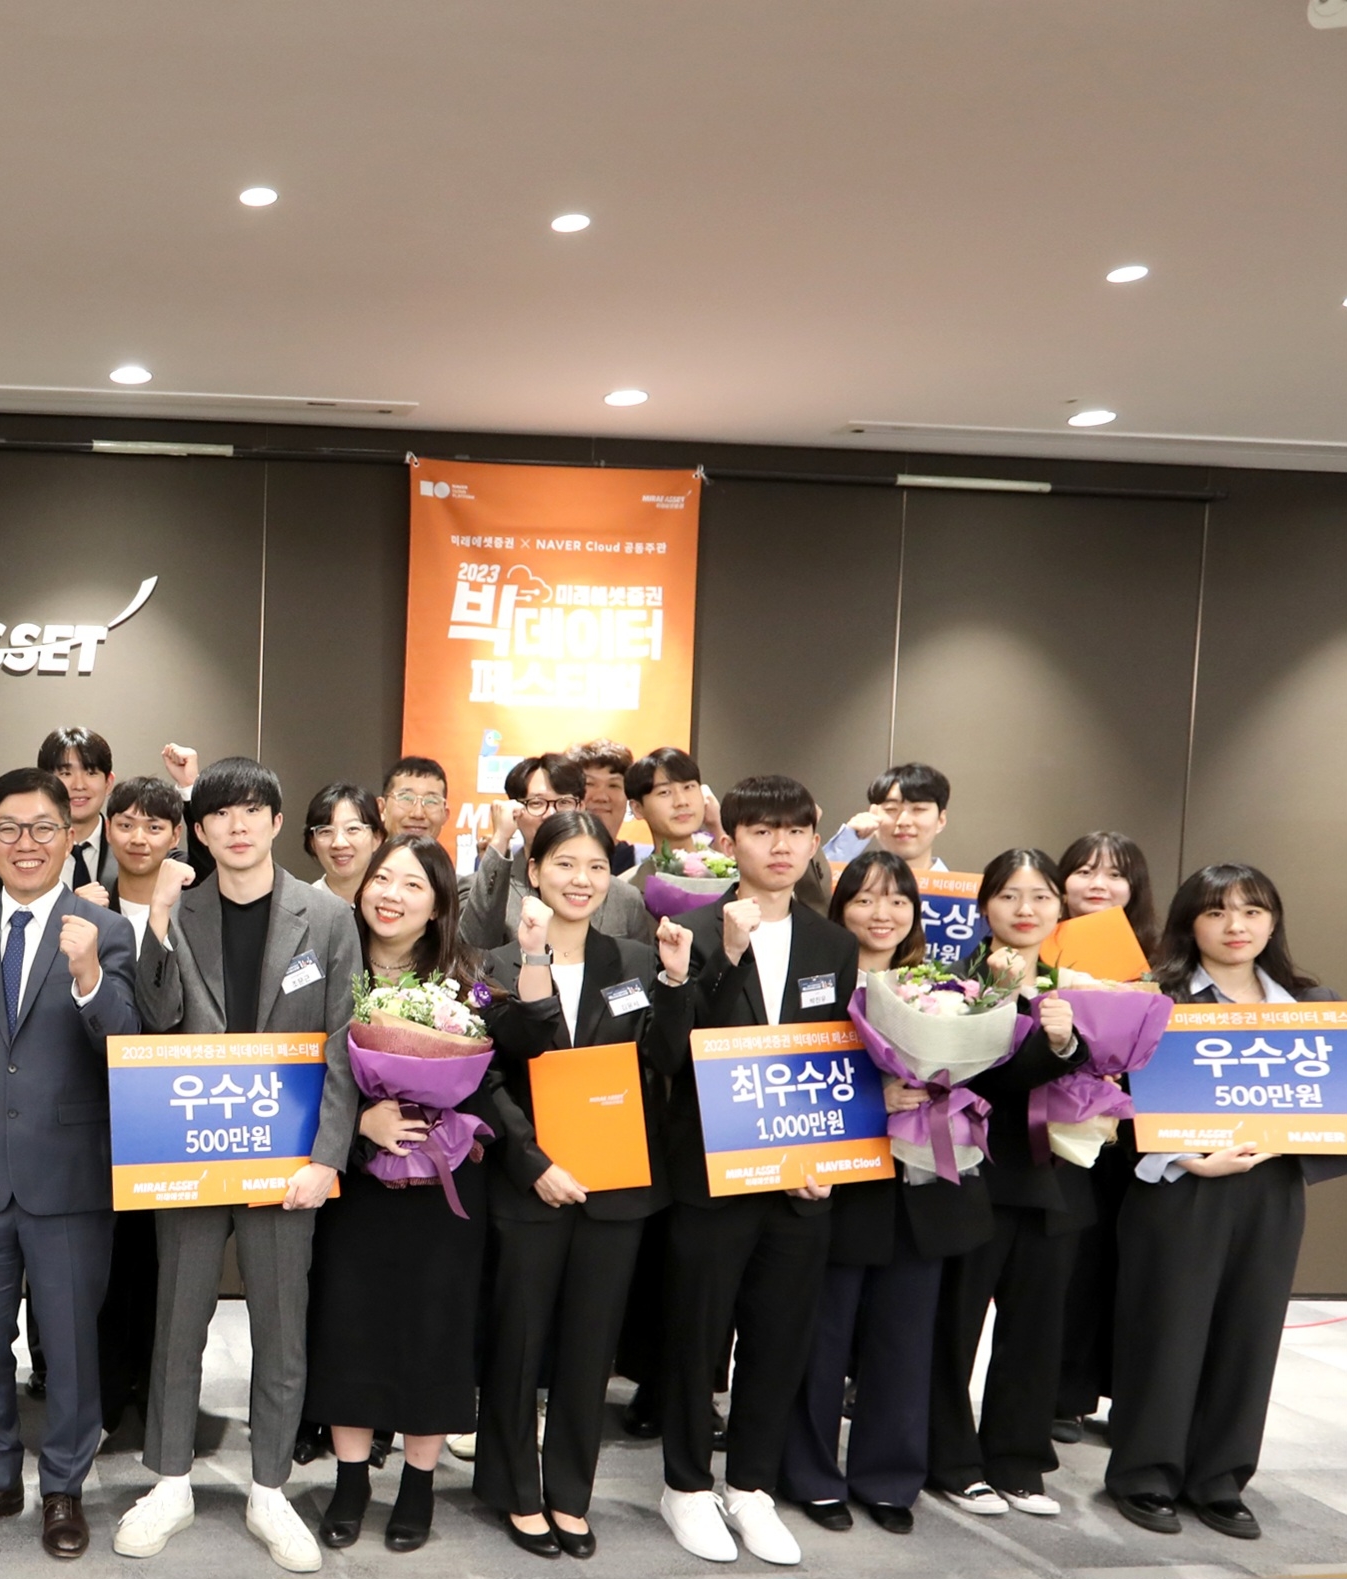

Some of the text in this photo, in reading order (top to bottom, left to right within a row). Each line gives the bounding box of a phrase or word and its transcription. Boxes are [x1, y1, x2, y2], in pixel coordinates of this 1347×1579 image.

[451, 534, 515, 550] 미래에셋증권
[536, 538, 581, 551] NAVER
[585, 540, 620, 553] Cloud
[624, 541, 667, 555] 공동주관
[458, 562, 501, 584] 2023
[555, 586, 663, 607] 미래에셋증권
[933, 879, 978, 894] 빅데이터
[1174, 1012, 1258, 1025] 미래에셋증권
[1261, 1011, 1319, 1024] 빅데이터
[122, 1042, 320, 1060] 2023 미래에셋증권 빅데이터 페스티벌
[703, 1031, 862, 1052] 2023 미래에셋증권 빅데이터 페스티
[1192, 1035, 1334, 1078] 우수상
[730, 1058, 855, 1109] 최우수상
[169, 1071, 283, 1121] 우수상
[1214, 1084, 1324, 1108] 500만원
[756, 1109, 845, 1142] 1,000만원
[1157, 1128, 1234, 1140] MIRAE ASSET
[185, 1125, 272, 1154] 500만원
[1287, 1131, 1346, 1144] NAVER
[725, 1164, 781, 1178] MIRAE ASSET
[816, 1156, 881, 1173] NAVER Cloud
[133, 1180, 200, 1194] MIRAE ASSET
[242, 1177, 286, 1191] NAVER
